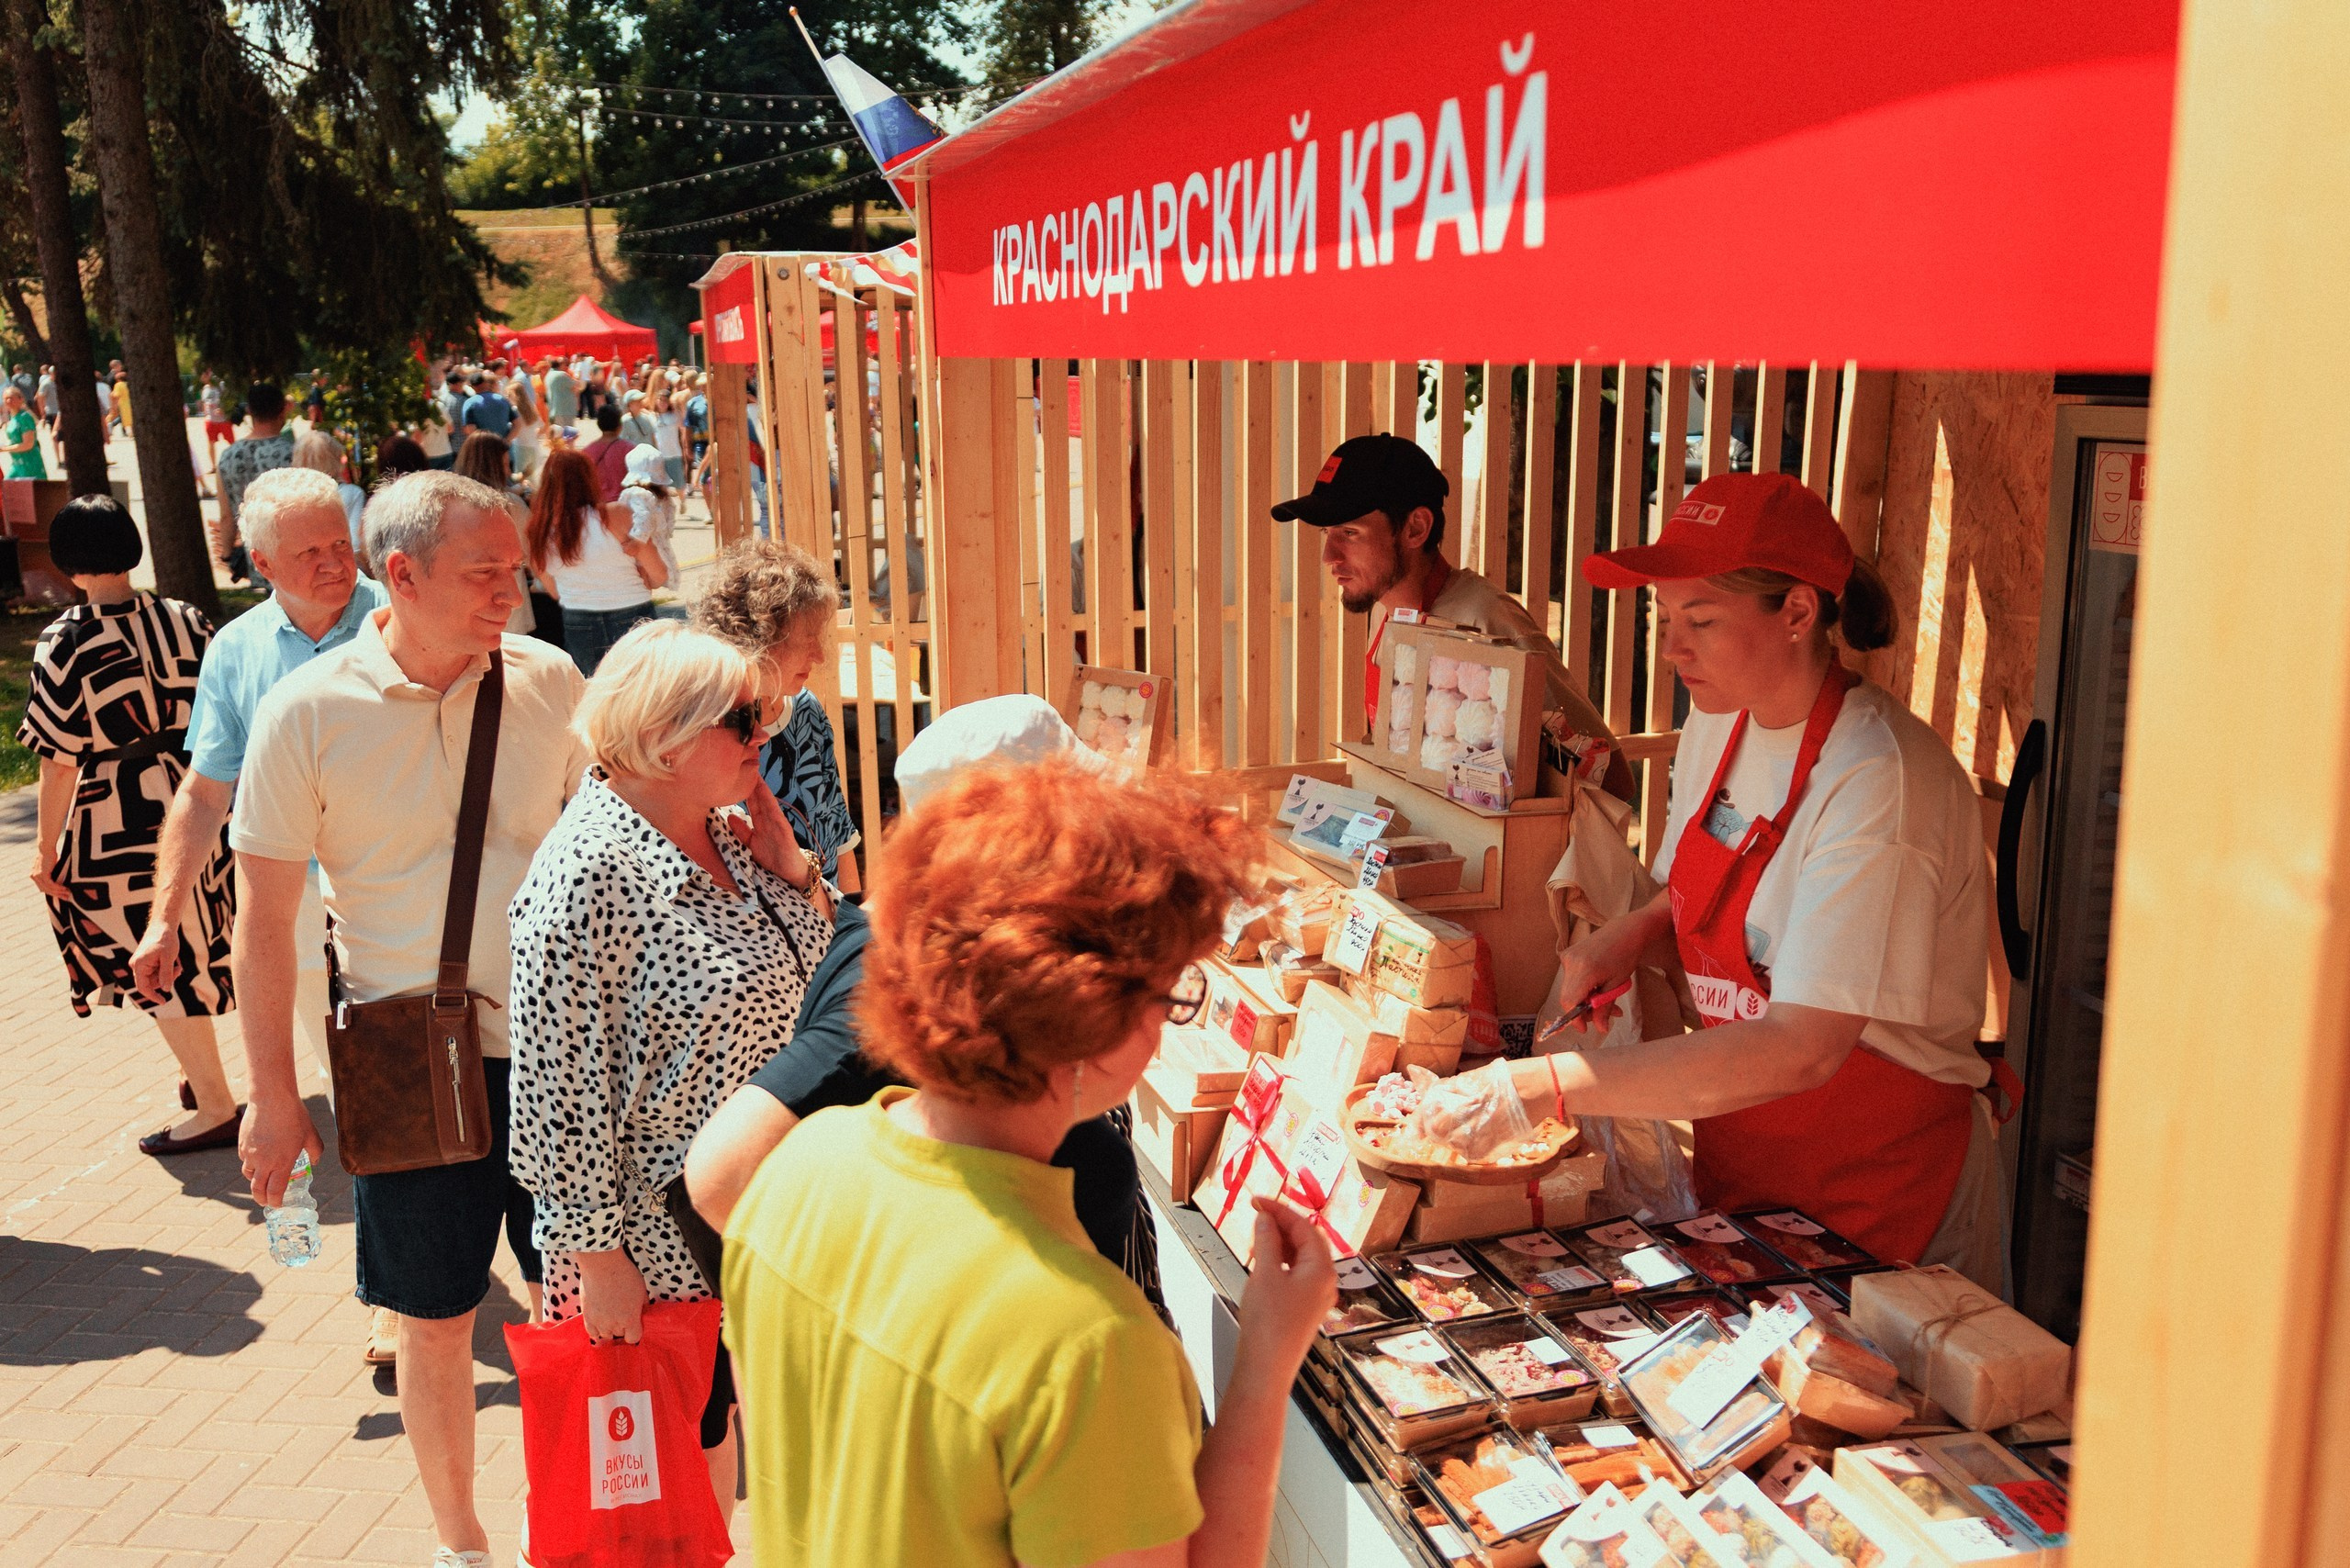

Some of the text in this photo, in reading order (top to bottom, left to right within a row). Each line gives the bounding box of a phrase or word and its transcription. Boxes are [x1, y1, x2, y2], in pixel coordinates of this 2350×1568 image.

[993, 31, 1549, 315] КРАСНОДАРСКИЙ КРАЙ
[606, 1453, 643, 1475] ВКУСЫ
[602, 1473, 648, 1494] РОССИИ
